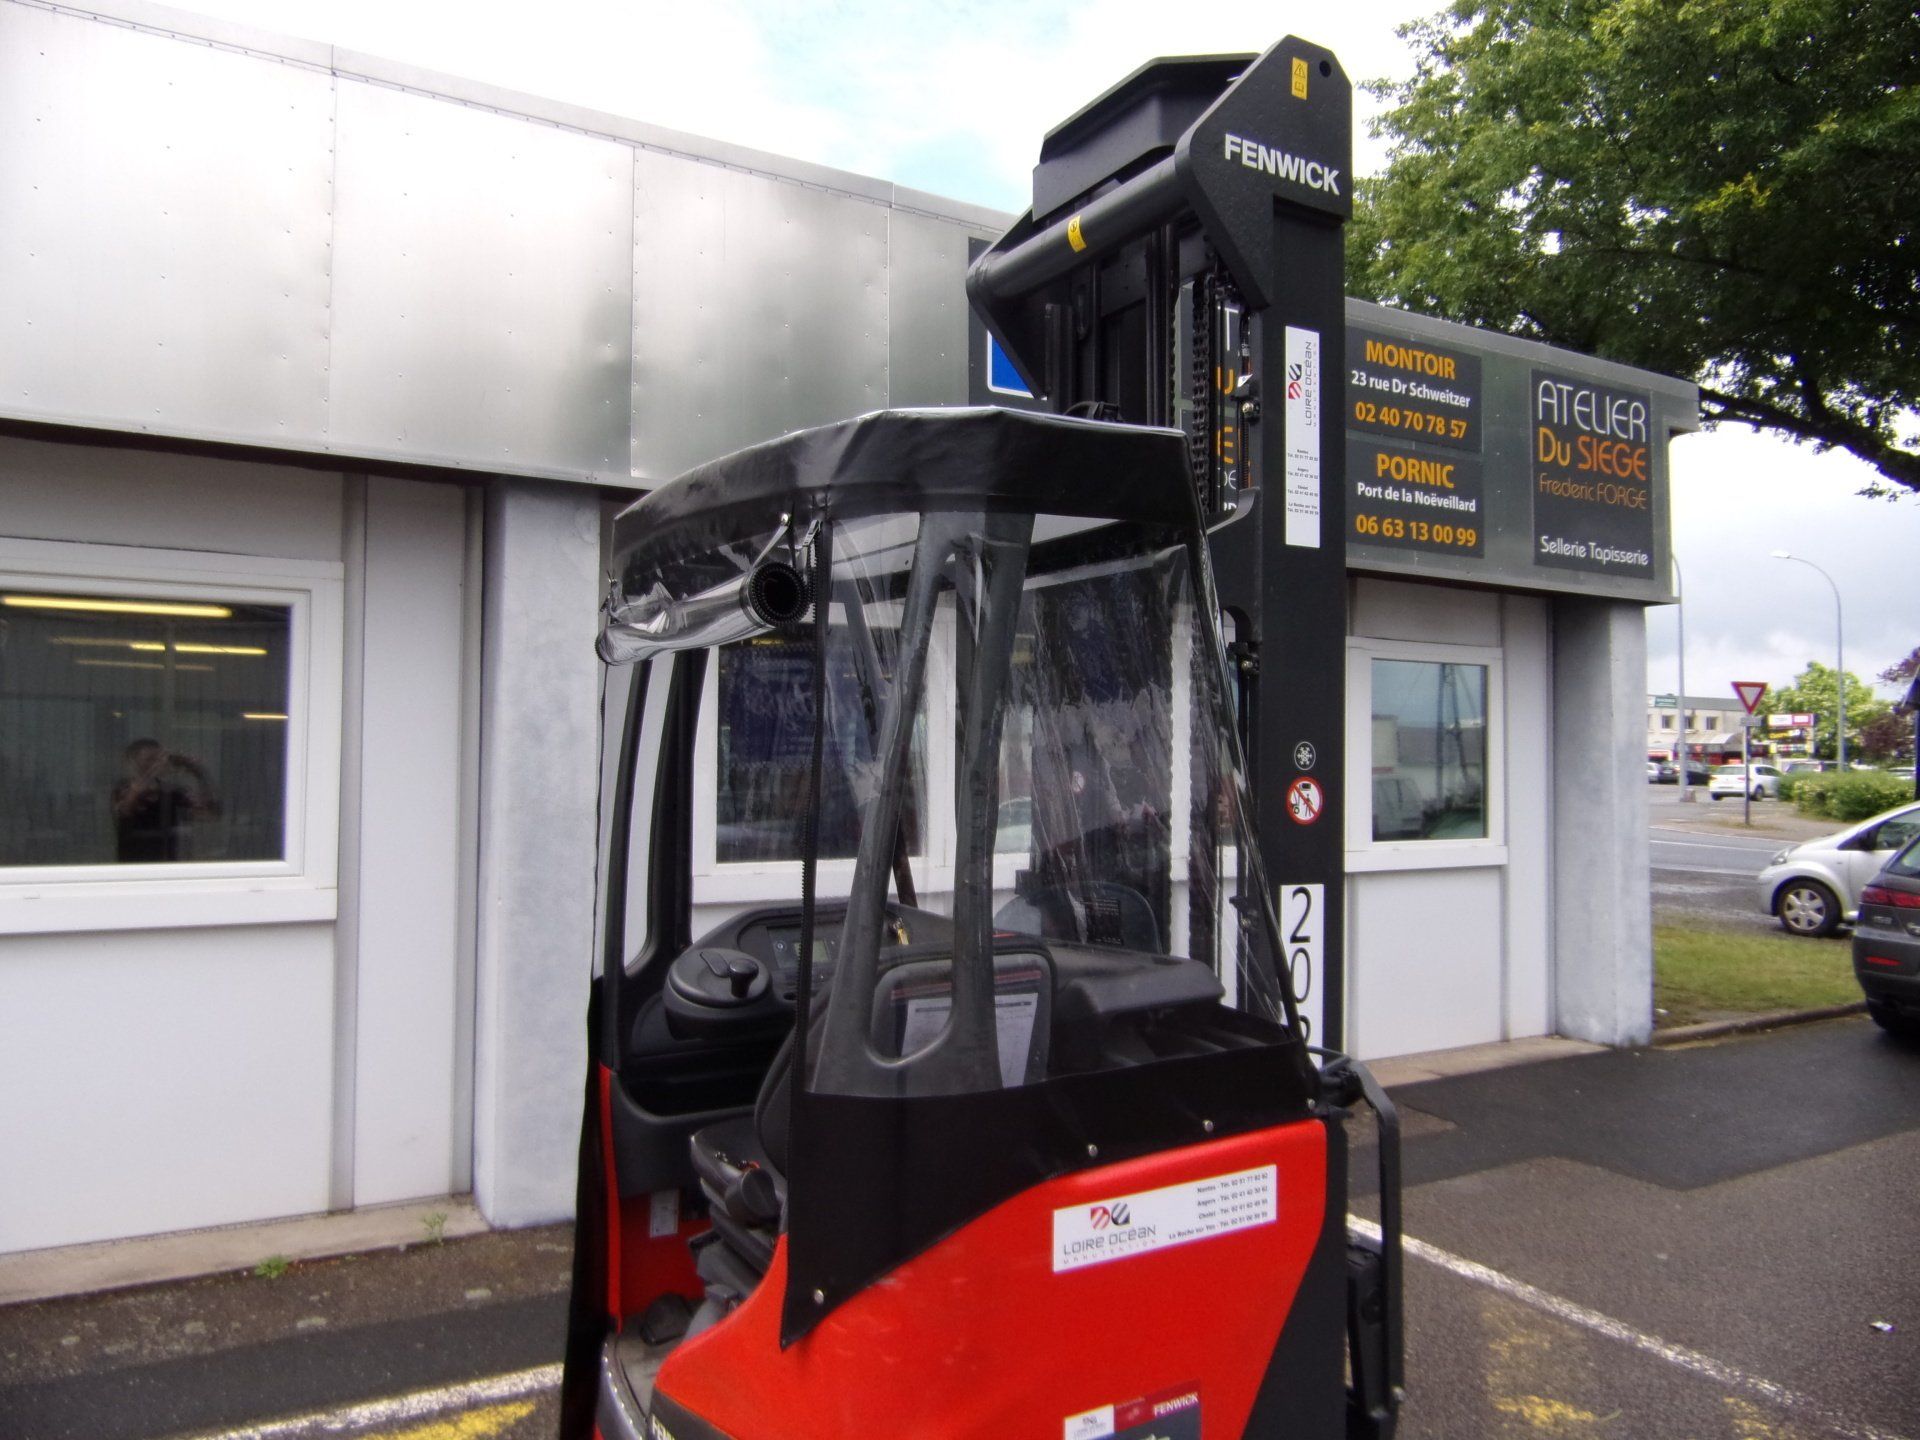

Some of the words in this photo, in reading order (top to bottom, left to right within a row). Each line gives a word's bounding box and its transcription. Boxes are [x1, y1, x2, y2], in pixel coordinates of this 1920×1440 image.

[1225, 133, 1340, 196] FENWICK
[1366, 340, 1456, 380] MONTOIR
[1351, 370, 1366, 386] 23
[1369, 377, 1389, 391] rue
[1392, 379, 1407, 394] Dr
[1409, 382, 1470, 407] Schweitzer
[1355, 401, 1376, 422] 02
[1379, 406, 1400, 427] 40
[1404, 410, 1423, 431] 70
[1426, 415, 1445, 435] 78
[1450, 419, 1467, 439] 57
[1538, 380, 1646, 442] ATELIER
[1376, 453, 1455, 488] PORNIC
[1539, 427, 1571, 467] Du
[1576, 434, 1647, 481] SIEGE
[1357, 482, 1382, 499] Port
[1385, 486, 1399, 500] de
[1402, 488, 1412, 502] la
[1415, 491, 1476, 512] Noëveillard
[1539, 472, 1595, 501] Frederic
[1597, 482, 1647, 509] FORGE
[1356, 514, 1379, 535] 06
[1382, 517, 1404, 538] 63
[1409, 521, 1429, 541] 13
[1433, 524, 1453, 544] 00
[1456, 527, 1477, 547] 99
[1540, 535, 1587, 558] Sellerie
[1588, 542, 1649, 566] Tapisserie
[1153, 1392, 1198, 1417] FENWICK
